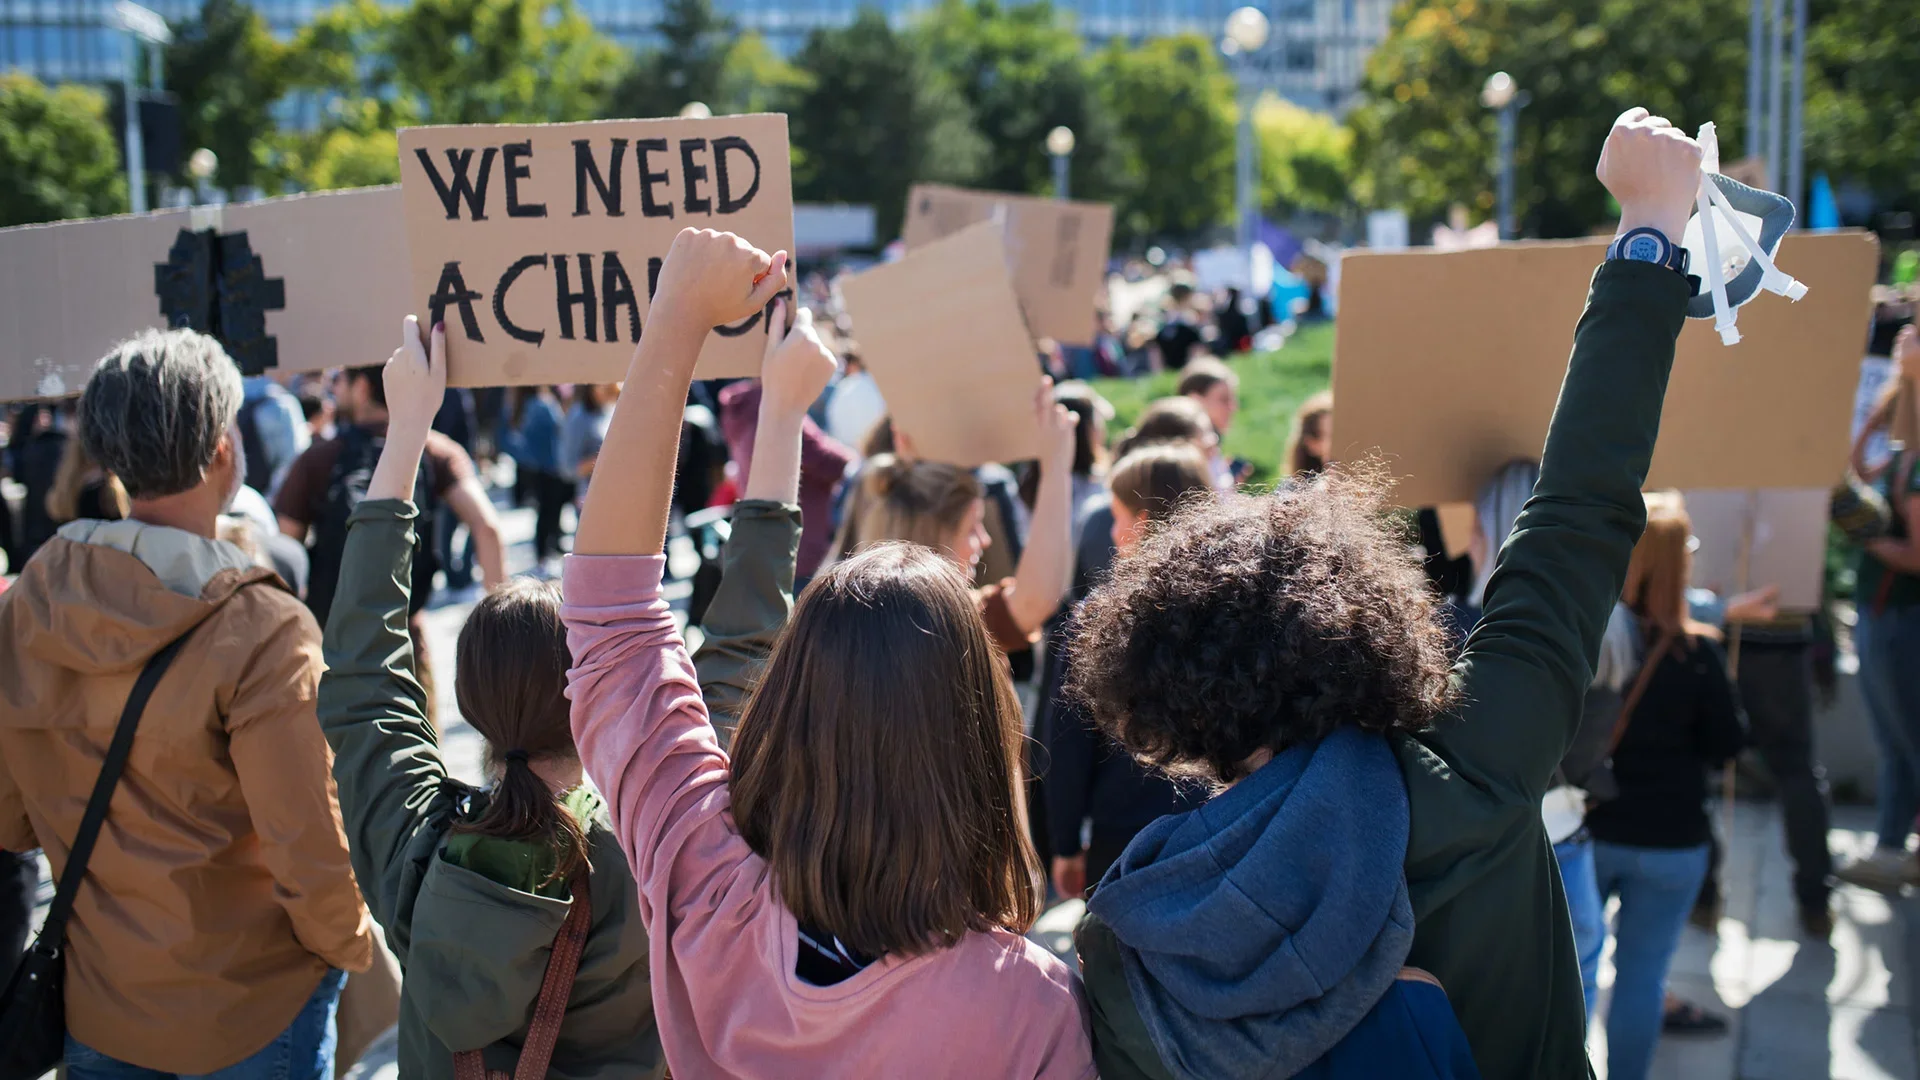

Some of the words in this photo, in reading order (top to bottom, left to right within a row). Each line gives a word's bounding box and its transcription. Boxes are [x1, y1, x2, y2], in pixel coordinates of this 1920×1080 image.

[414, 139, 548, 221] WE
[571, 136, 761, 220] NEED
[428, 261, 486, 344] A
[493, 250, 794, 348] CHA
